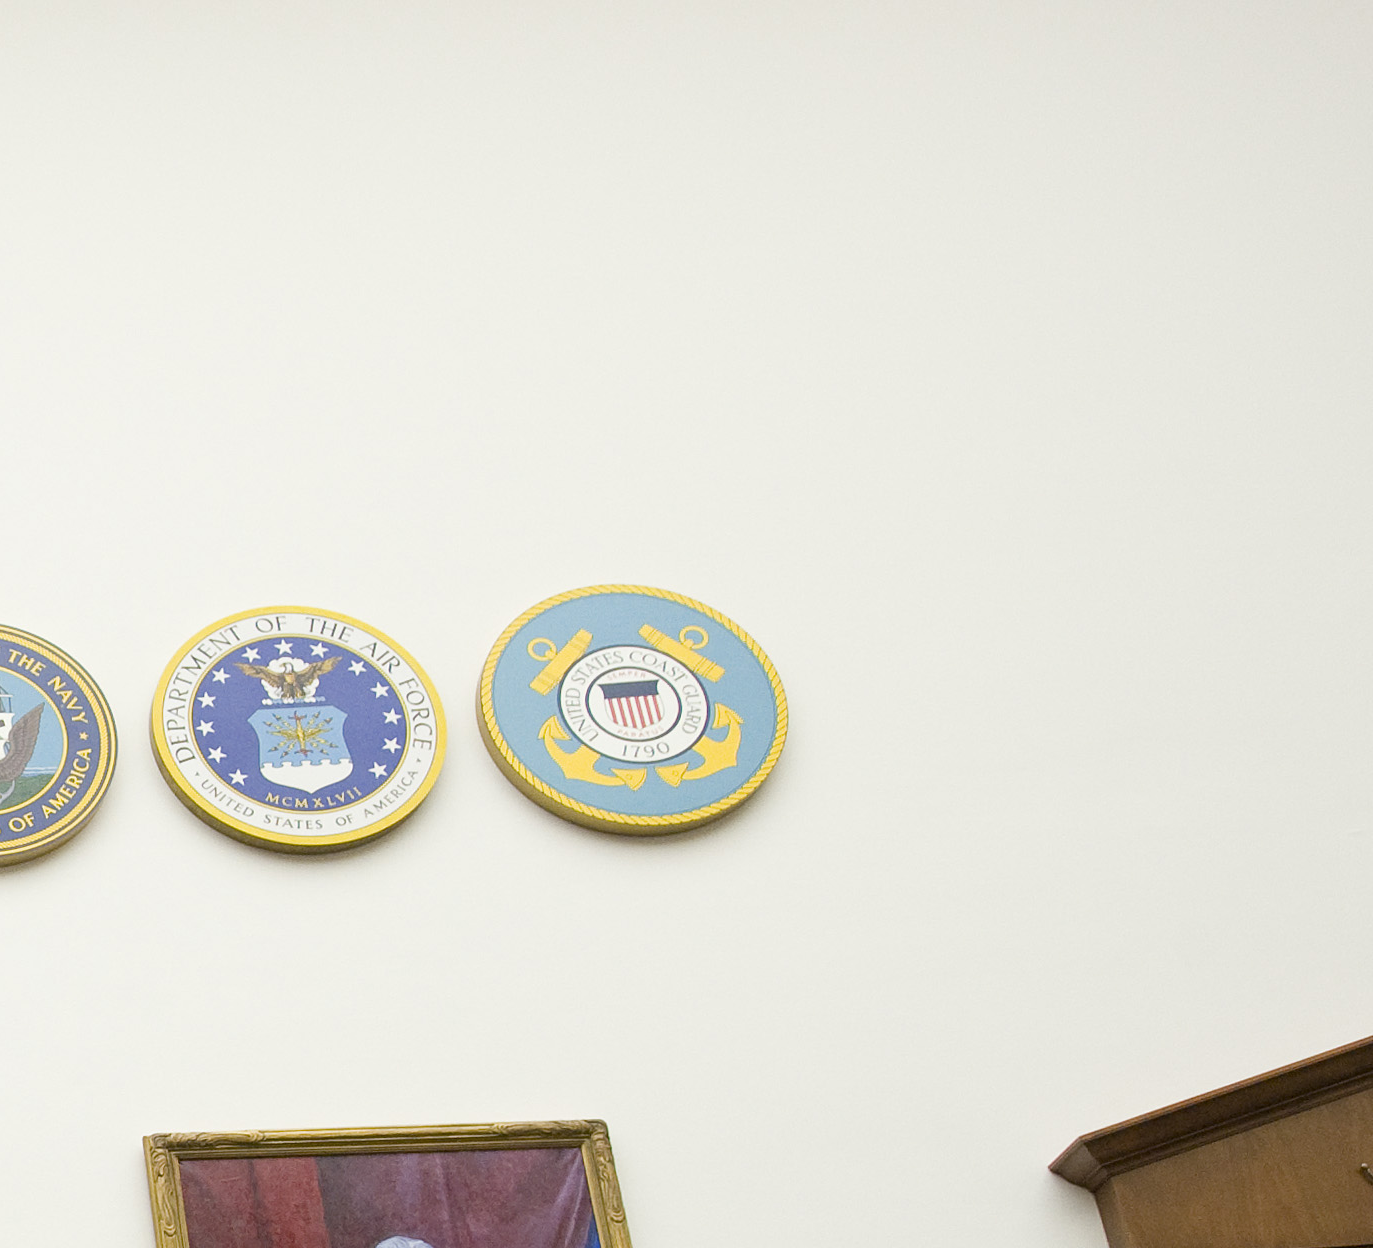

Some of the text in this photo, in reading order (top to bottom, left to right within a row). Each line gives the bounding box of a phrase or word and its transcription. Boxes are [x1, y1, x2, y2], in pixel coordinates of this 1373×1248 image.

[8, 648, 46, 677] THE
[47, 675, 89, 725] NAVY
[166, 615, 432, 765] DEPARTMENT OF THE AIR FORCE
[565, 650, 702, 742] UNITED STATES COAST GUARD
[622, 742, 670, 758] 1790
[8, 812, 35, 833] OF
[41, 747, 93, 820] AMERICA
[200, 768, 419, 830] UNITED STATES OF AMERICA
[265, 786, 363, 809] MCMXLVII
